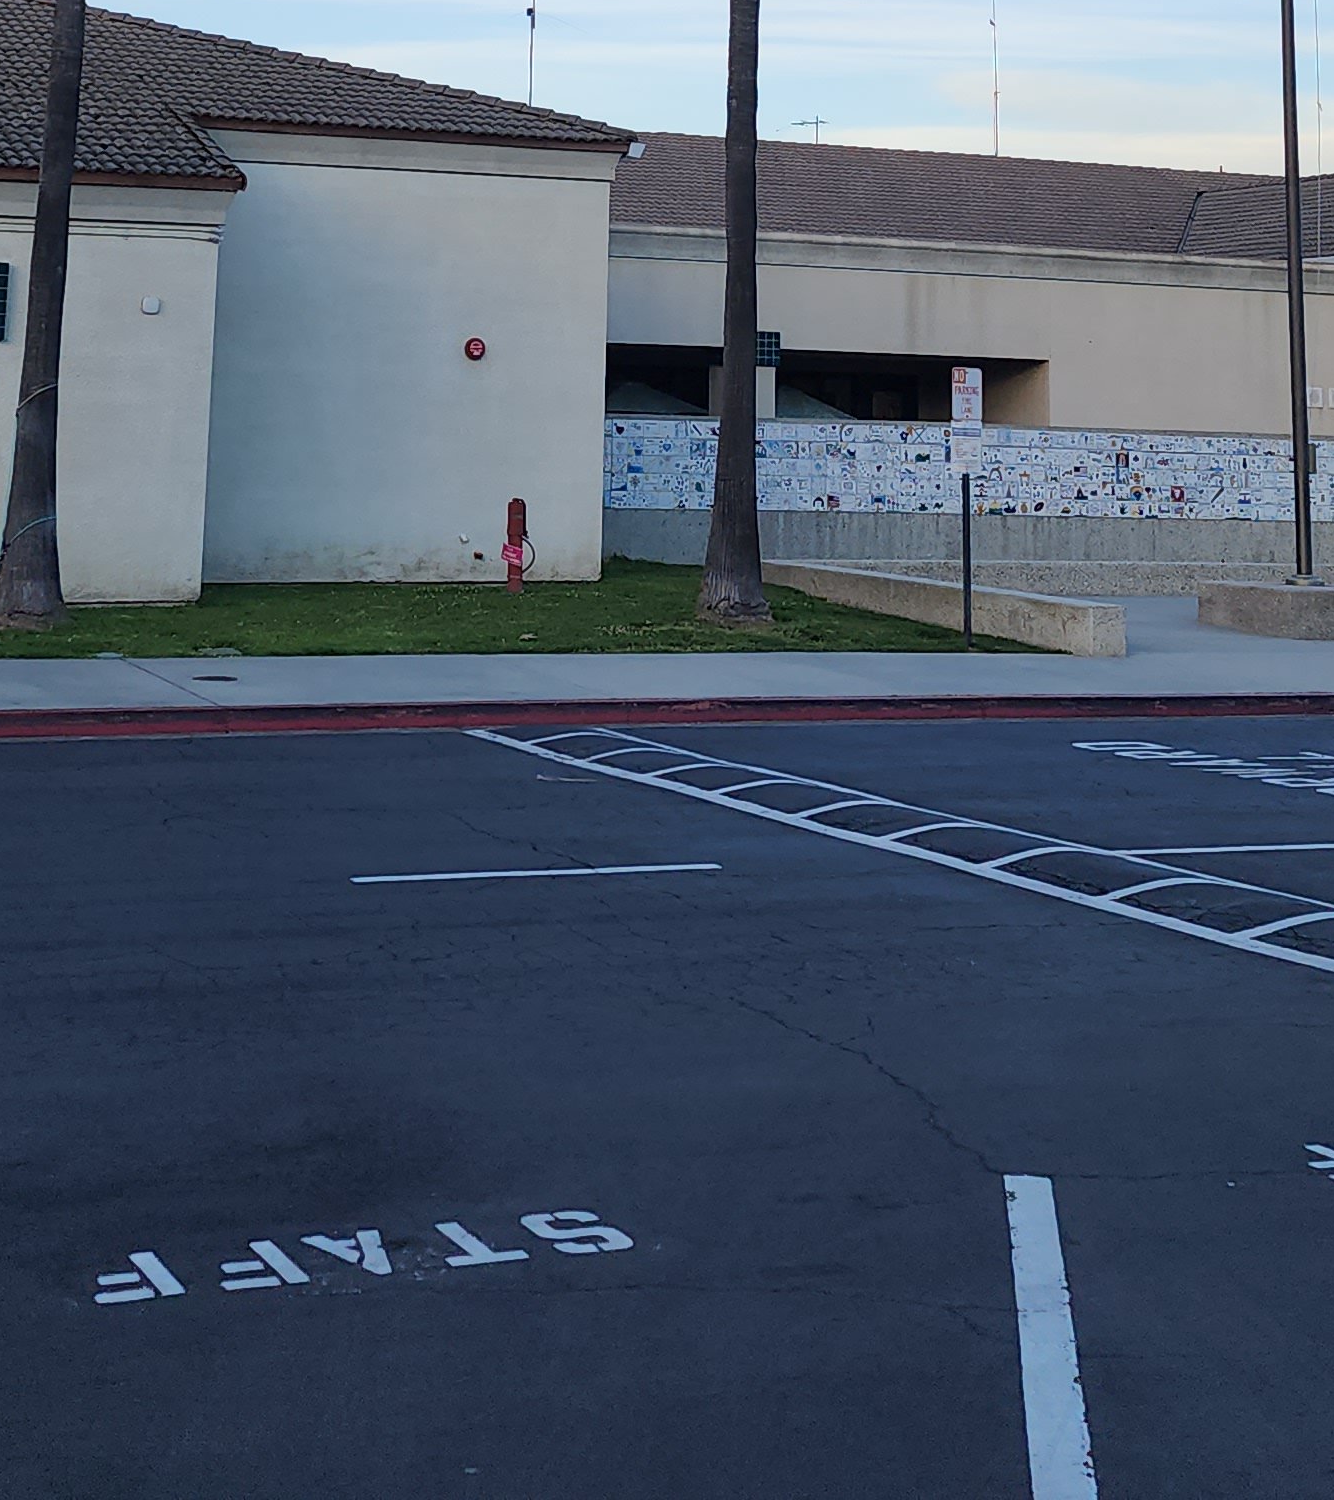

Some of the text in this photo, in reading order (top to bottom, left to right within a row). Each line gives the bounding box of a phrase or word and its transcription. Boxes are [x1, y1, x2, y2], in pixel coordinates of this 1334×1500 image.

[953, 369, 965, 382] NO
[955, 386, 979, 396] PARKING
[94, 1210, 635, 1304] STAFF
